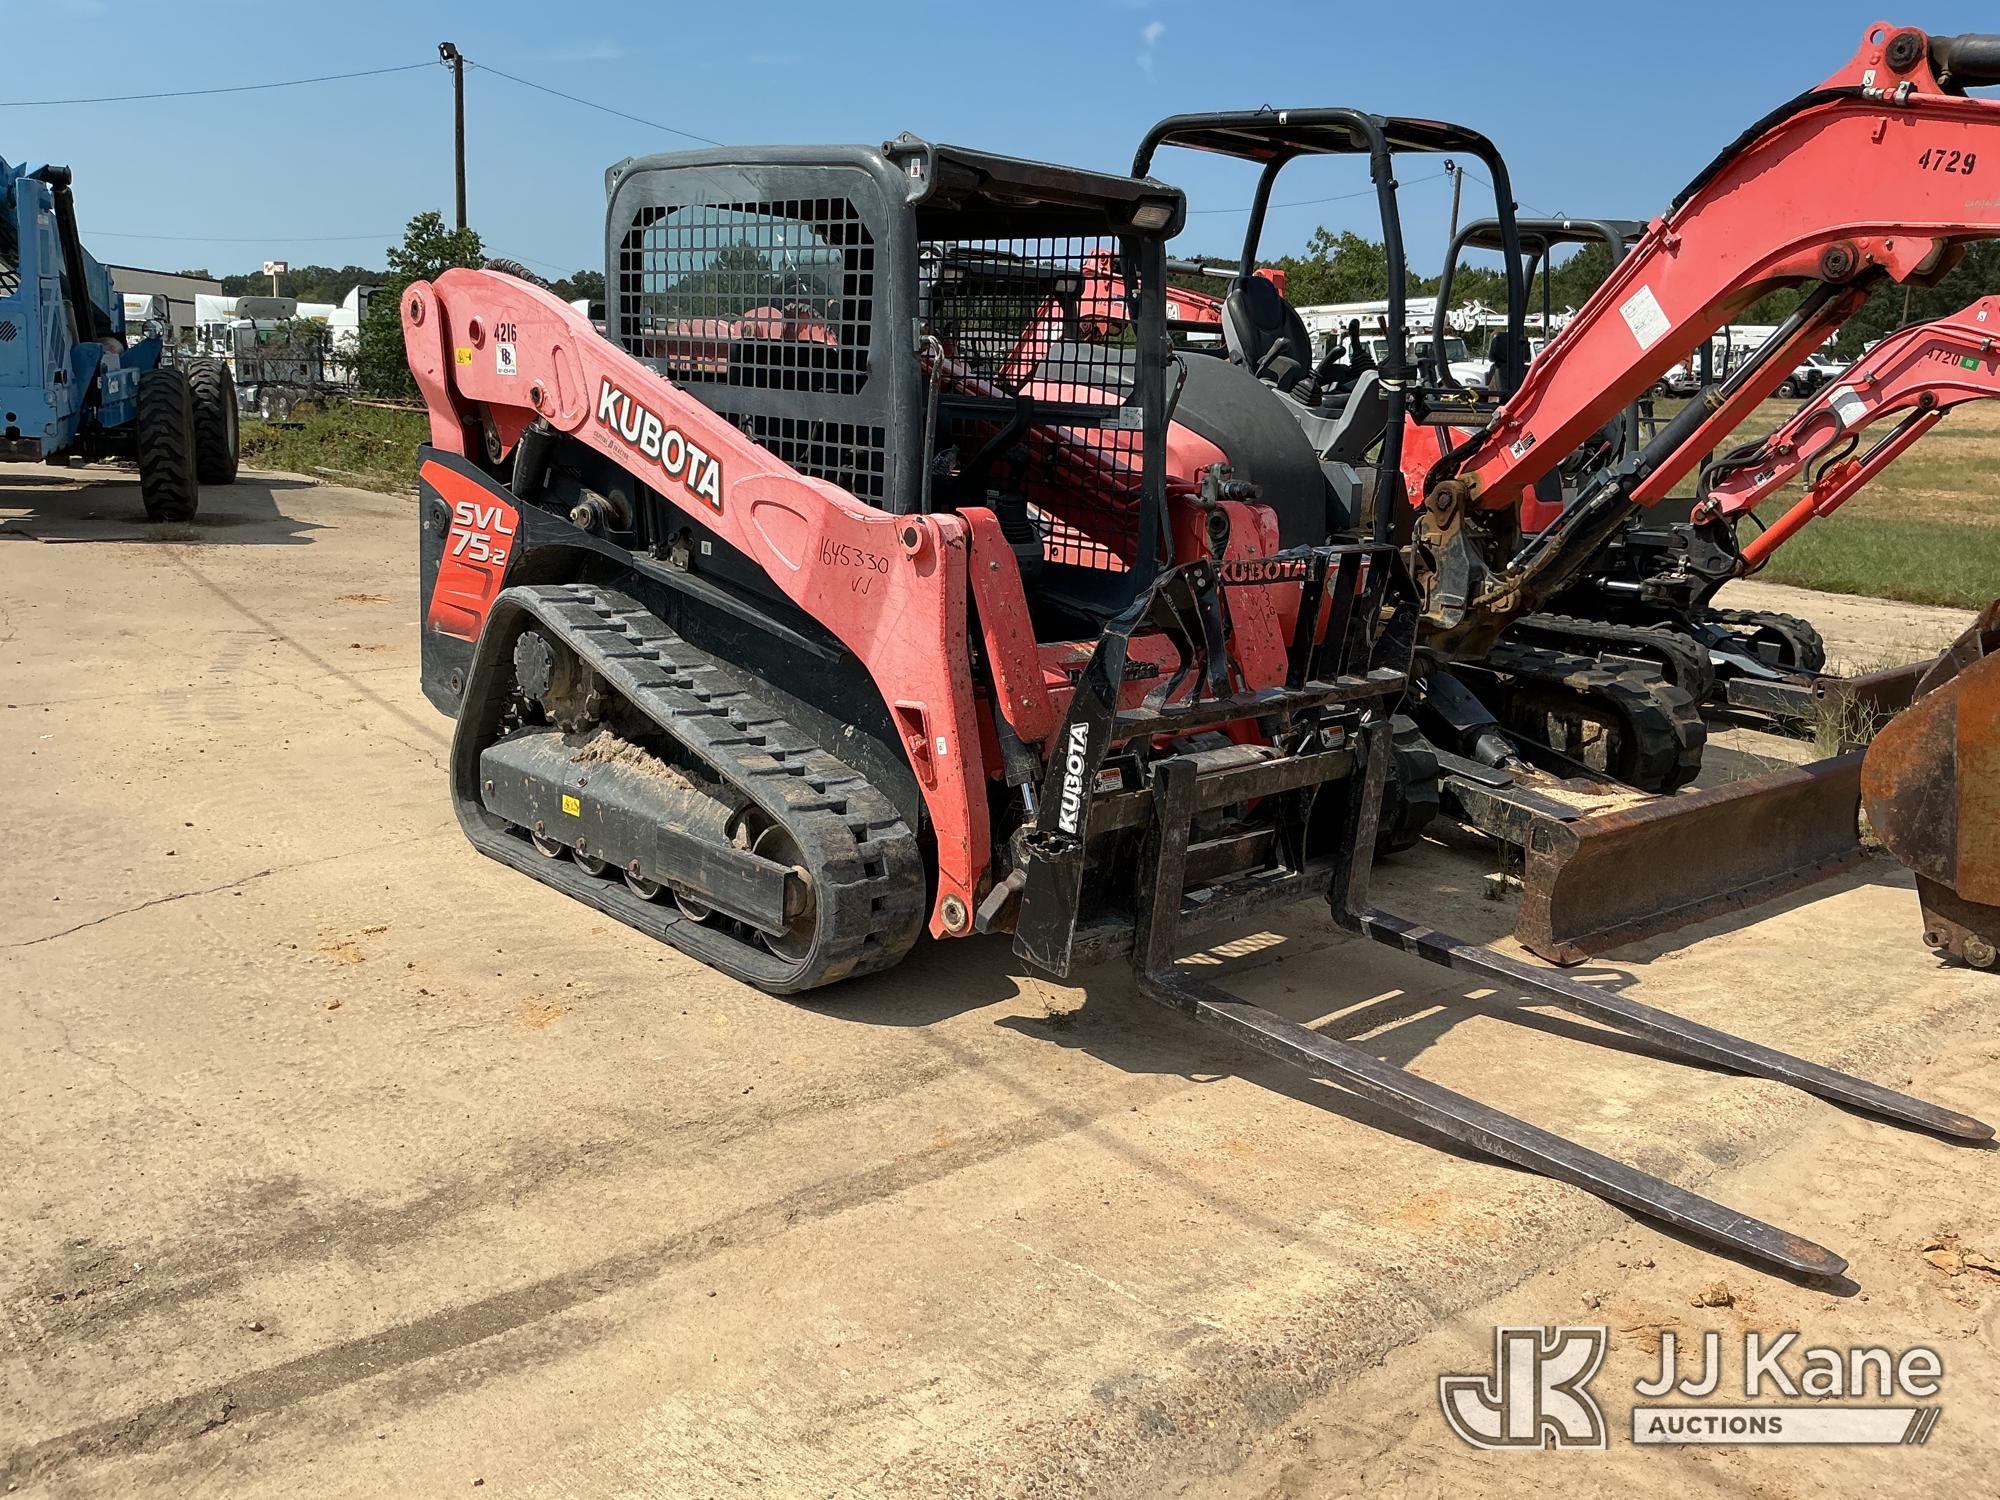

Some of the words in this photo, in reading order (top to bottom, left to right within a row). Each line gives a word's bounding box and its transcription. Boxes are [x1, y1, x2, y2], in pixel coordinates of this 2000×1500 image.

[1918, 147, 1977, 175] 4729
[493, 322, 517, 342] 4216
[1926, 346, 1961, 367] 4720
[598, 379, 721, 509] KUBOTA
[453, 501, 513, 536] SVL
[818, 535, 889, 574] 1645330
[1219, 558, 1308, 583] KUBOTA
[1058, 722, 1089, 834] KUBOTA
